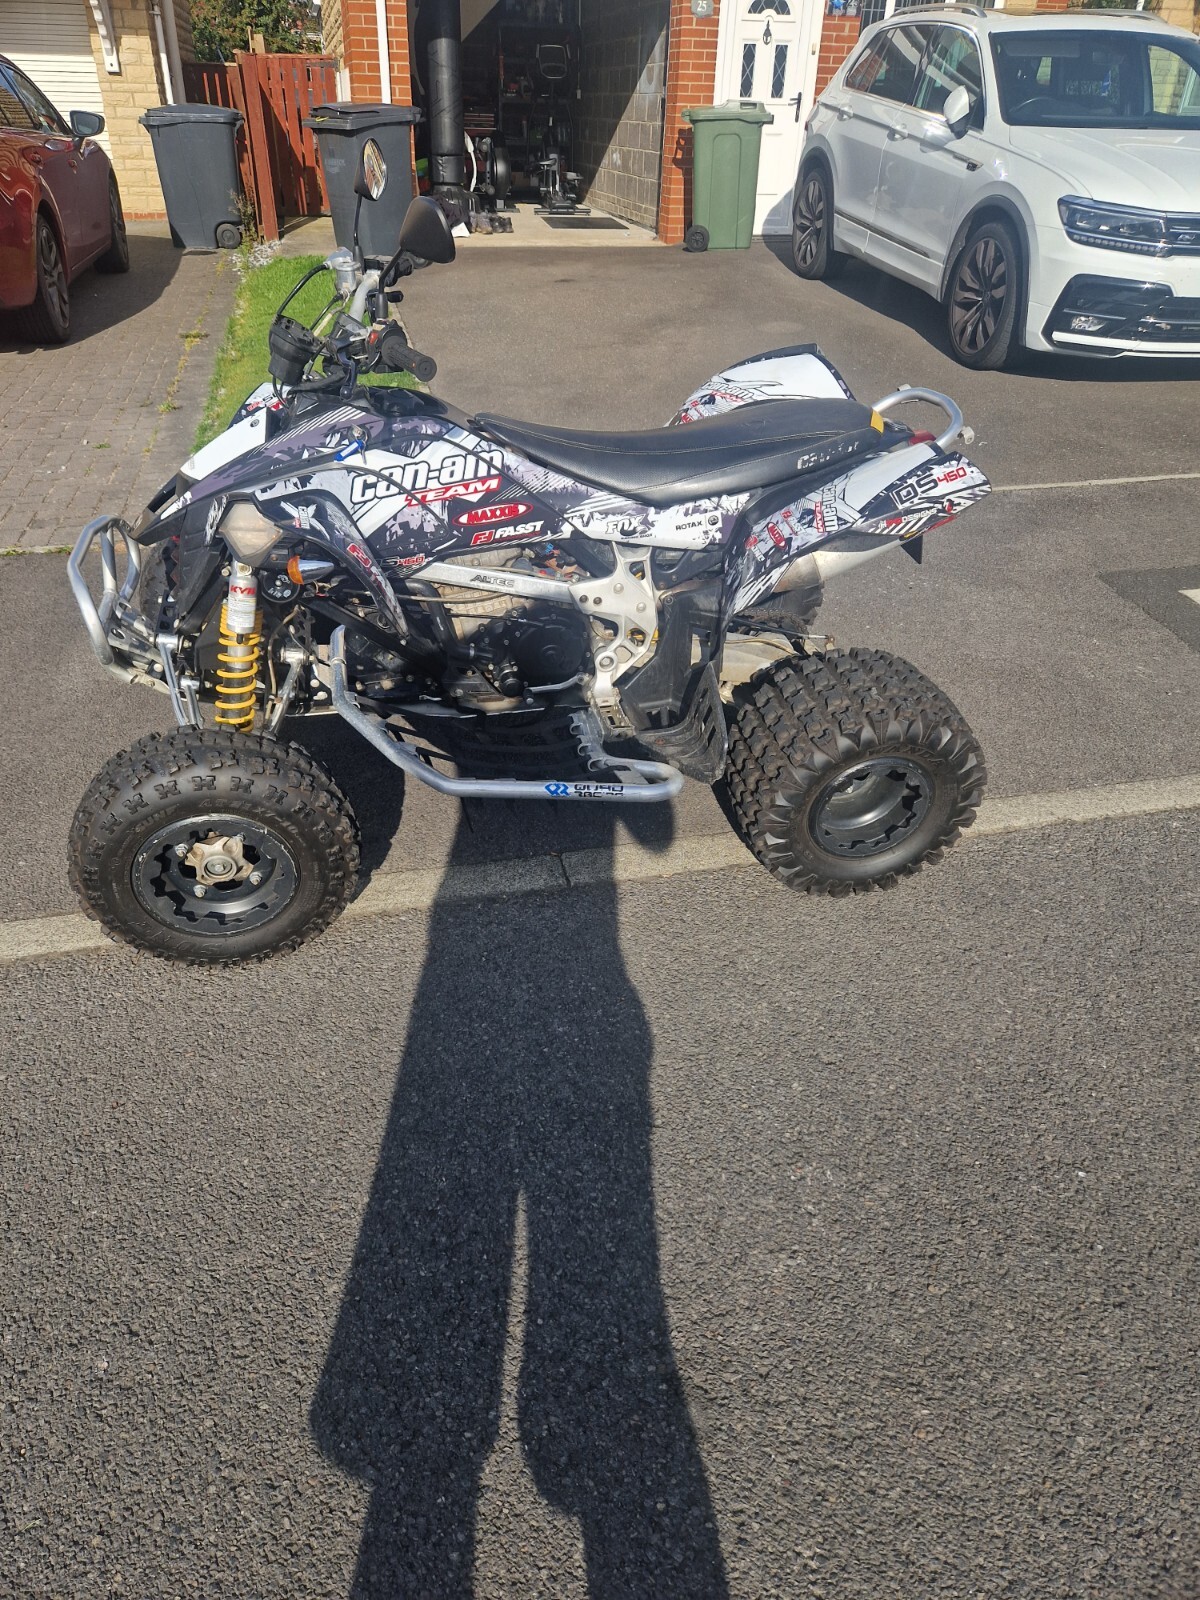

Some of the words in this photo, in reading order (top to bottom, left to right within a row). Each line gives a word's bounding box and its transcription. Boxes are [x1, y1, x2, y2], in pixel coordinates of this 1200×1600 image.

[697, 1, 707, 11] 25
[350, 449, 504, 505] can-am
[405, 477, 501, 507] TEAM
[467, 503, 520, 524] MAXXIS
[494, 521, 545, 539] FASST
[675, 521, 703, 531] ROTAX
[469, 574, 515, 588] ALTEC
